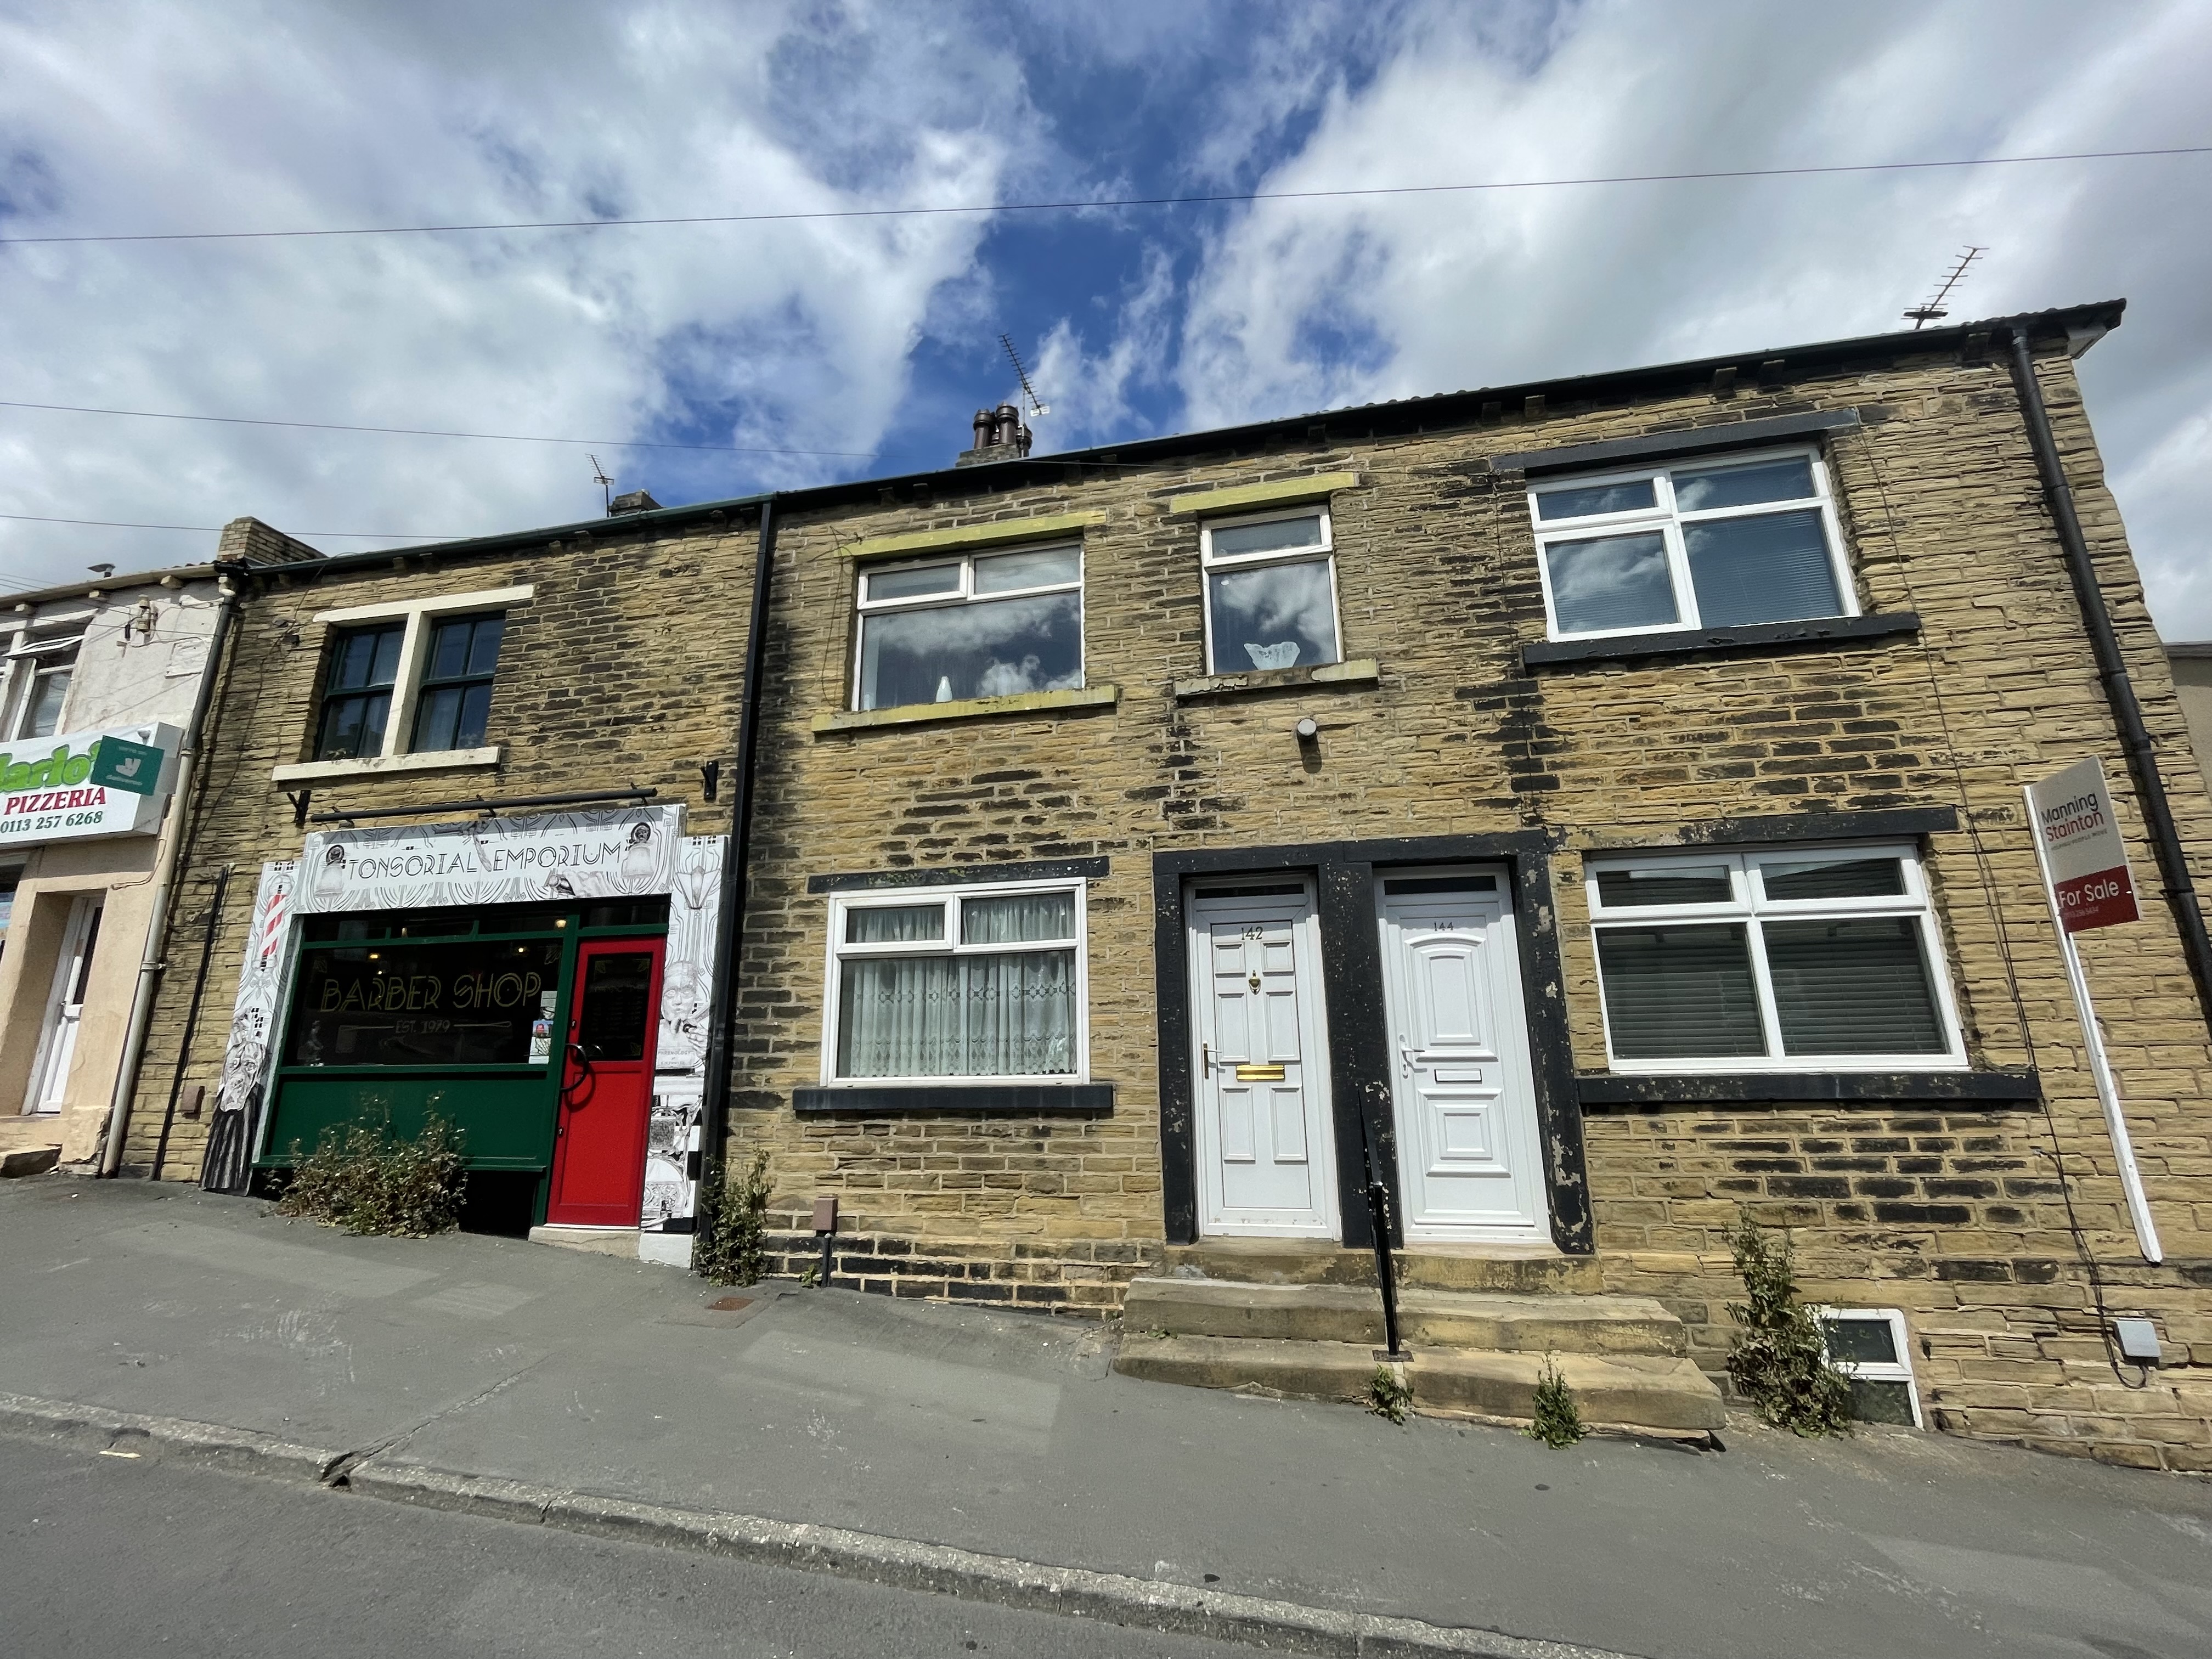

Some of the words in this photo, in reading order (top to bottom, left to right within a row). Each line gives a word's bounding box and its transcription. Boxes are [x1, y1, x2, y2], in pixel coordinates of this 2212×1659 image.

[4, 787, 106, 815] PIZZERIA
[2041, 793, 2099, 824] Manning
[1, 819, 31, 833] 0113
[35, 815, 63, 830] 257
[66, 811, 103, 826] 6268
[2045, 812, 2104, 842] Stainton
[348, 851, 477, 880] TONSORIAL
[493, 841, 621, 871] EMPORIUM
[2058, 890, 2081, 908] For
[2084, 878, 2119, 902] Sale
[1241, 926, 1263, 940] 142
[1434, 922, 1454, 932] 144
[320, 975, 441, 1013] BARBER
[453, 972, 541, 1009] SHOP
[395, 1020, 416, 1034] EST.
